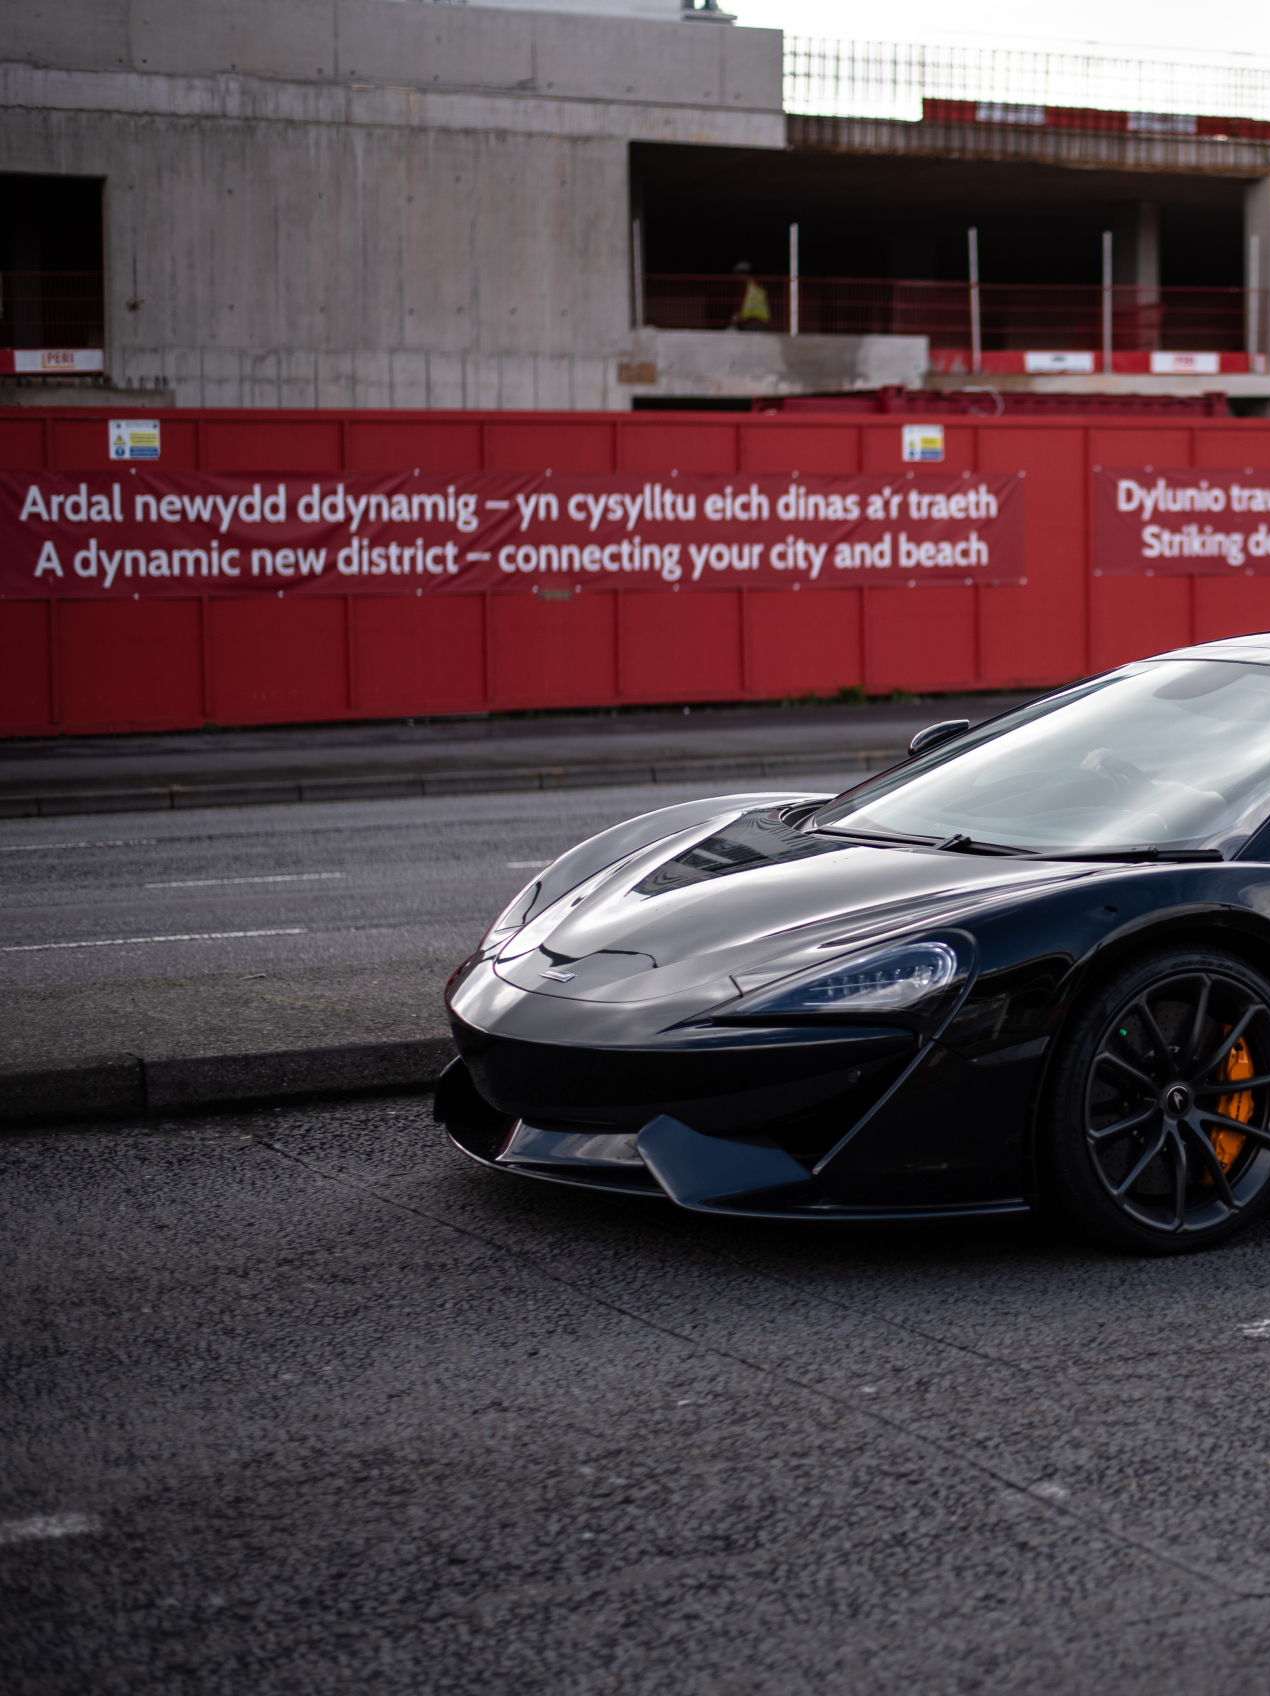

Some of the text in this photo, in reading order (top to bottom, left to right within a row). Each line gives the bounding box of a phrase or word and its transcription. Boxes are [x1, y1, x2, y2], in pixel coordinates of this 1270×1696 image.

[20, 484, 123, 522] Ardal
[136, 484, 287, 533] newydd
[298, 484, 479, 533] ddynamig
[516, 494, 559, 531] yn
[567, 483, 697, 532] cysylltu
[704, 484, 769, 521] eich
[776, 484, 861, 521] dinas
[908, 483, 998, 520] traeth
[1117, 479, 1226, 521] Dylunio
[34, 541, 64, 577] A
[74, 539, 240, 588] dynamic
[251, 548, 327, 576] new
[337, 537, 459, 575] district
[498, 536, 682, 582] connecting
[689, 544, 765, 581] your
[770, 535, 828, 580] city
[834, 533, 892, 569] and
[899, 533, 989, 567] beach
[1141, 524, 1245, 566] Striking
